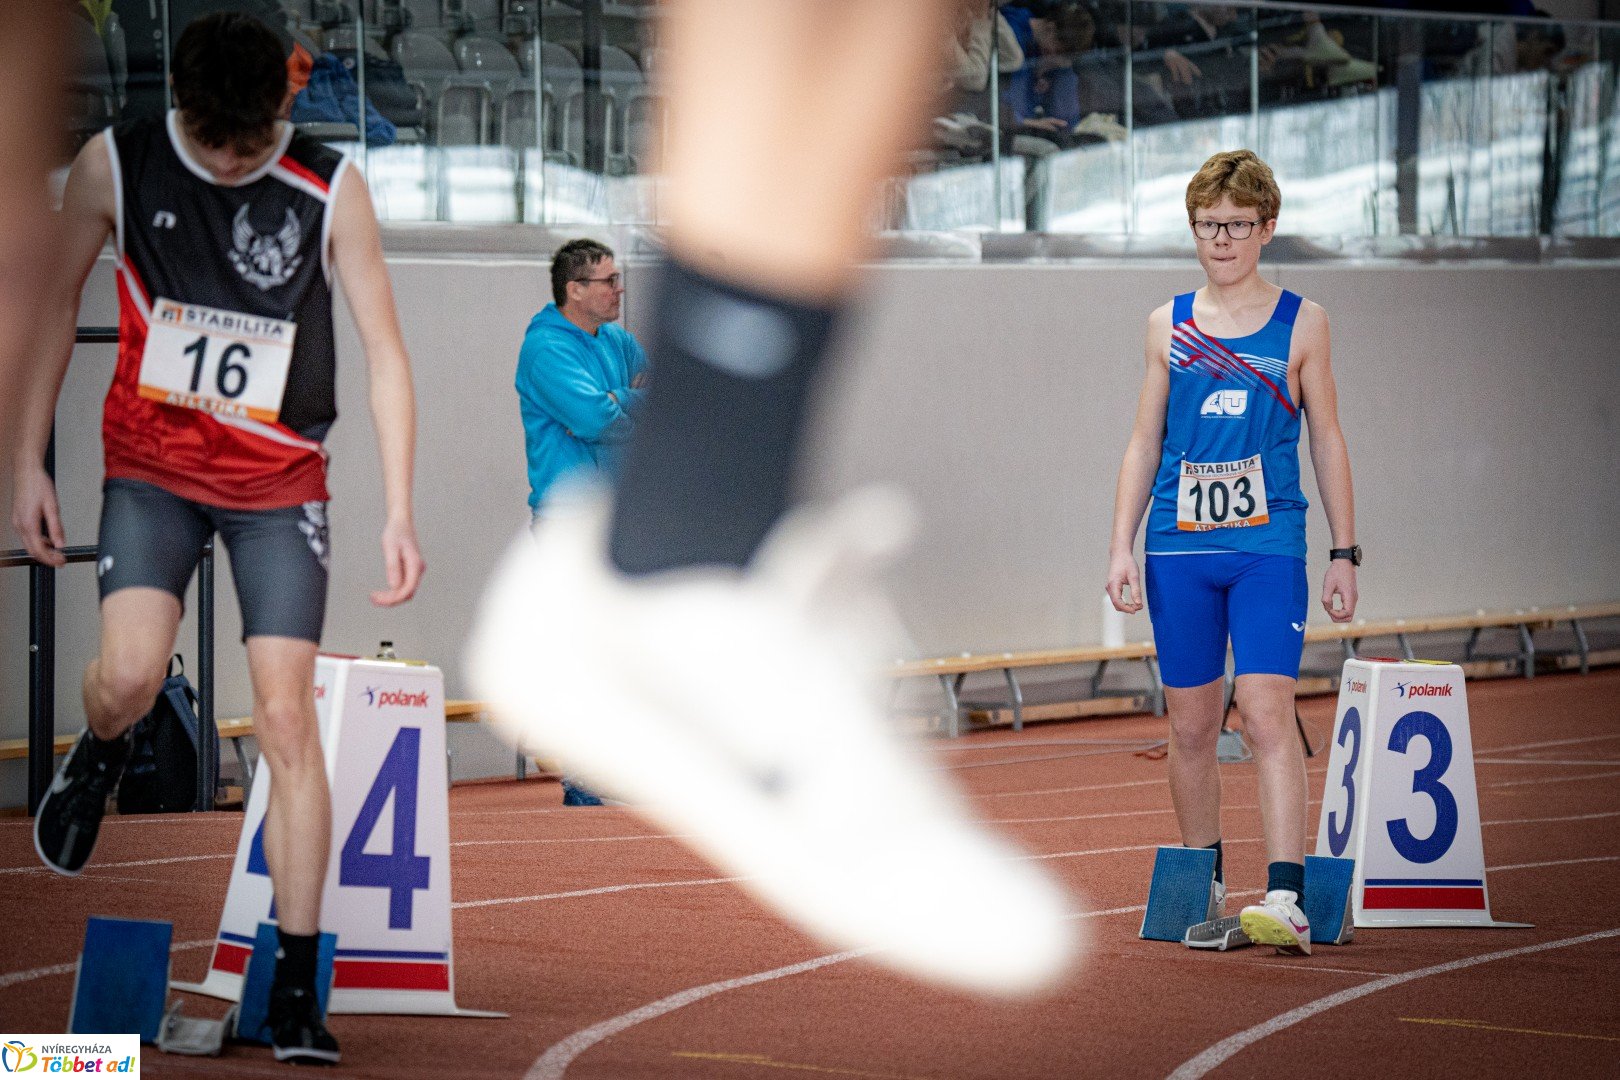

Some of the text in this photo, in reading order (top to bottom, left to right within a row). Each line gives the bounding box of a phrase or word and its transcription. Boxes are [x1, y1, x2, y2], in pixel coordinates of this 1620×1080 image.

[185, 308, 284, 335] STABILITA
[183, 335, 252, 398] 16
[1193, 459, 1255, 474] STABILITA
[1189, 476, 1256, 523] 103
[378, 687, 429, 709] polanik
[1408, 683, 1453, 699] polanik
[1328, 706, 1361, 857] 3
[1386, 710, 1458, 864] 3
[339, 727, 430, 930] 4
